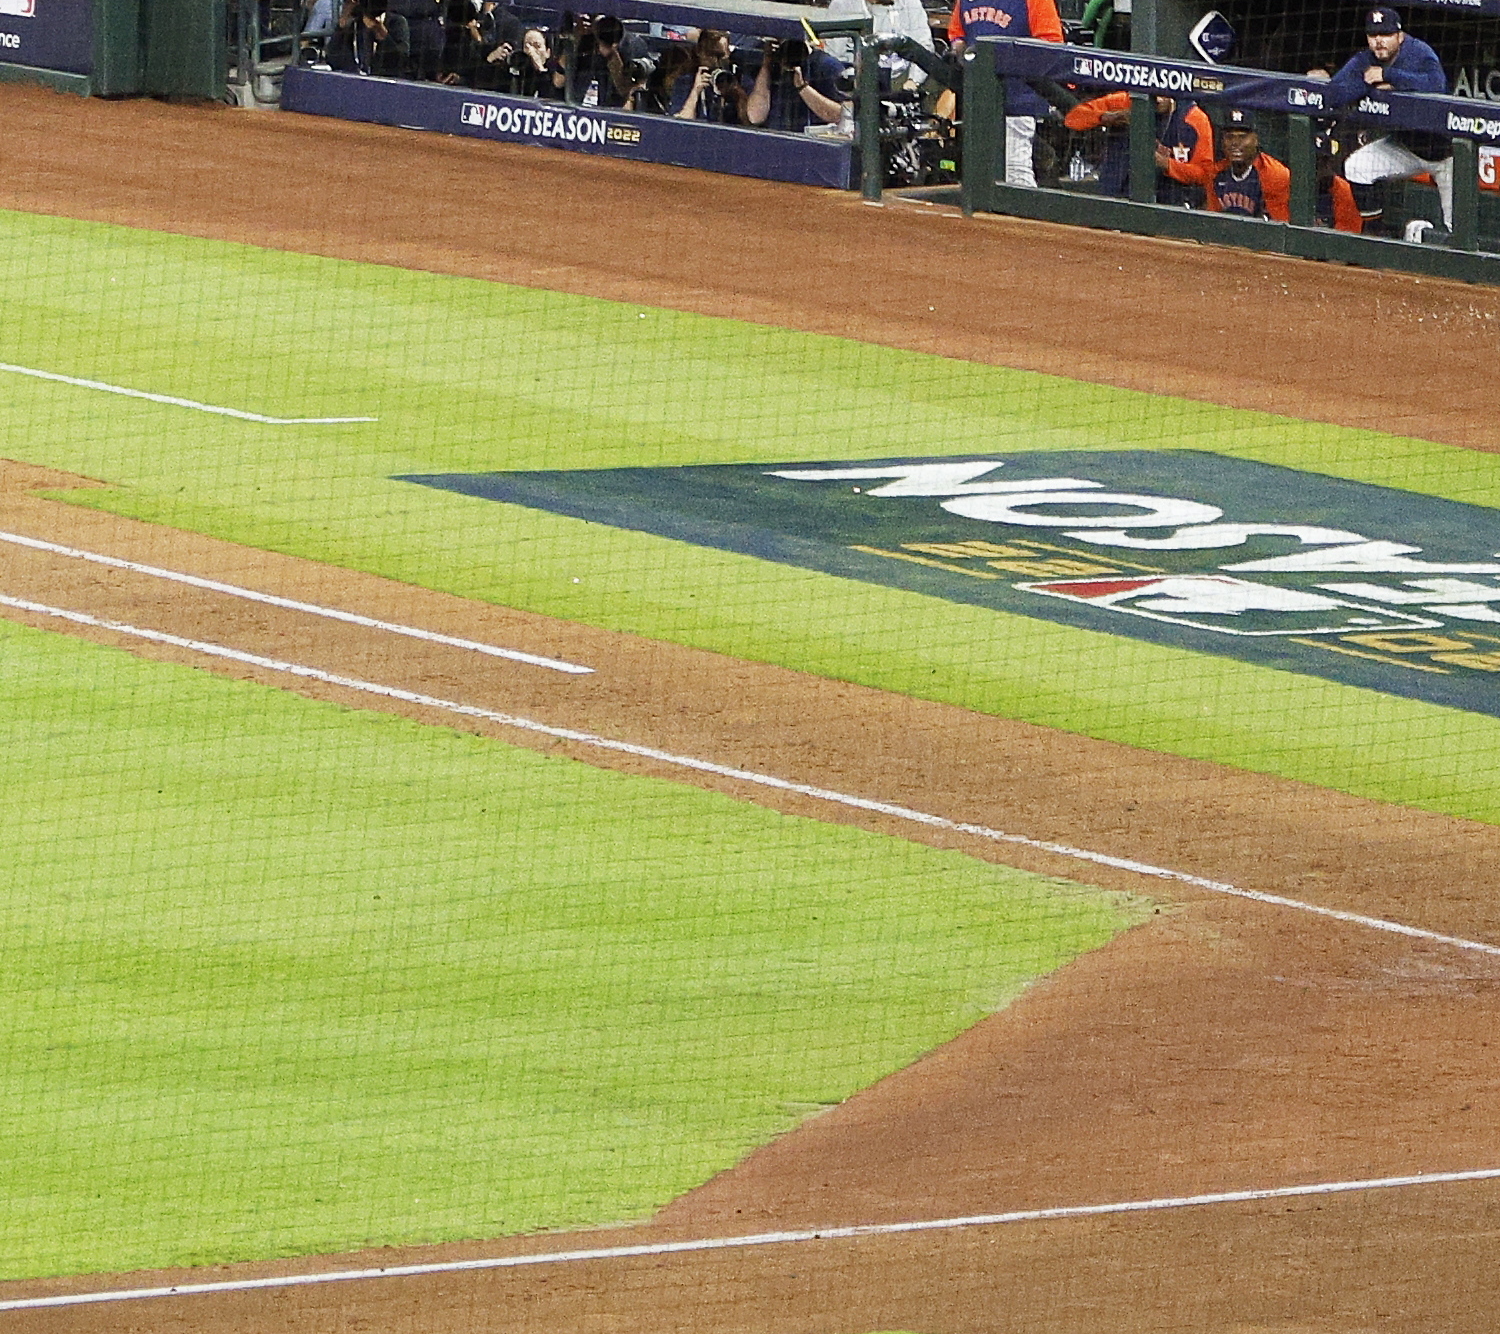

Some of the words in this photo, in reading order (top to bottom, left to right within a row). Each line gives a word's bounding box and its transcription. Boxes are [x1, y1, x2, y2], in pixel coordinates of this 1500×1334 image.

[1093, 59, 1193, 93] POSTSEASON
[484, 103, 607, 147] POSTSEASON
[606, 126, 641, 146] 2022
